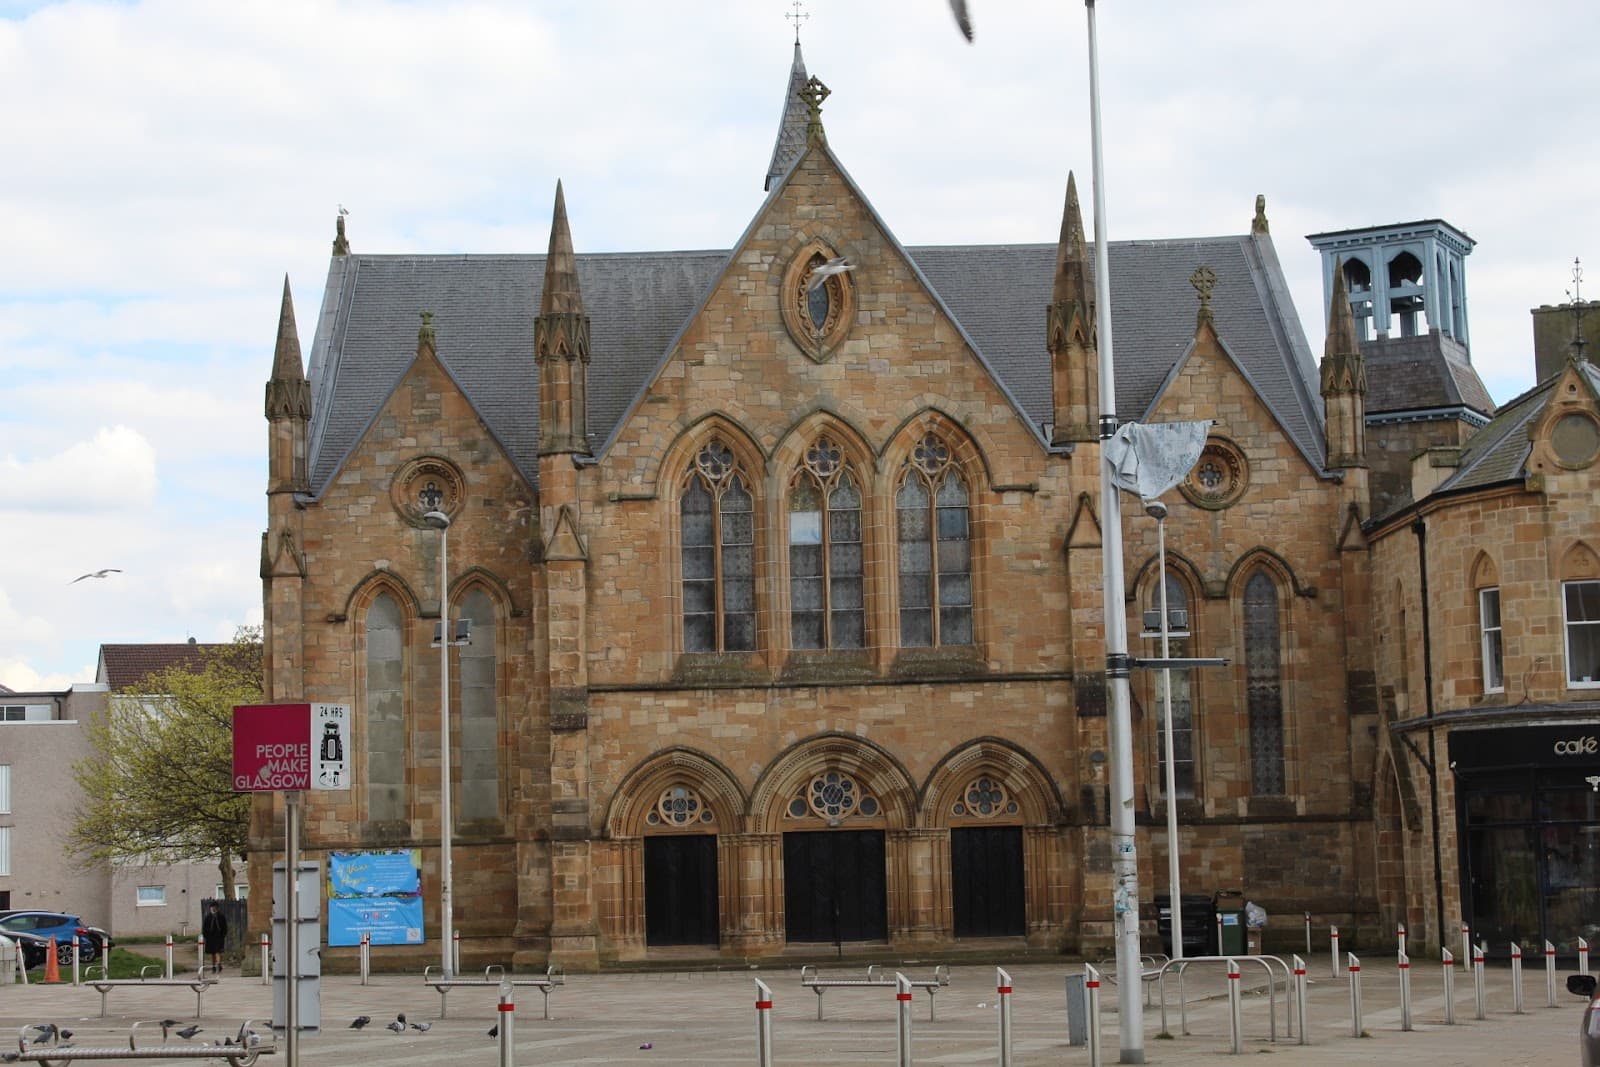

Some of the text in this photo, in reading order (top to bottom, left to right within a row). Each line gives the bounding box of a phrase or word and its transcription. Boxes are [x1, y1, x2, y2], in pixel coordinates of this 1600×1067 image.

[320, 706, 343, 718] 24 HRS
[256, 744, 309, 758] PEOPLE
[1554, 736, 1598, 754] café
[268, 759, 309, 773] MAKE
[235, 774, 308, 789] GLASGOW
